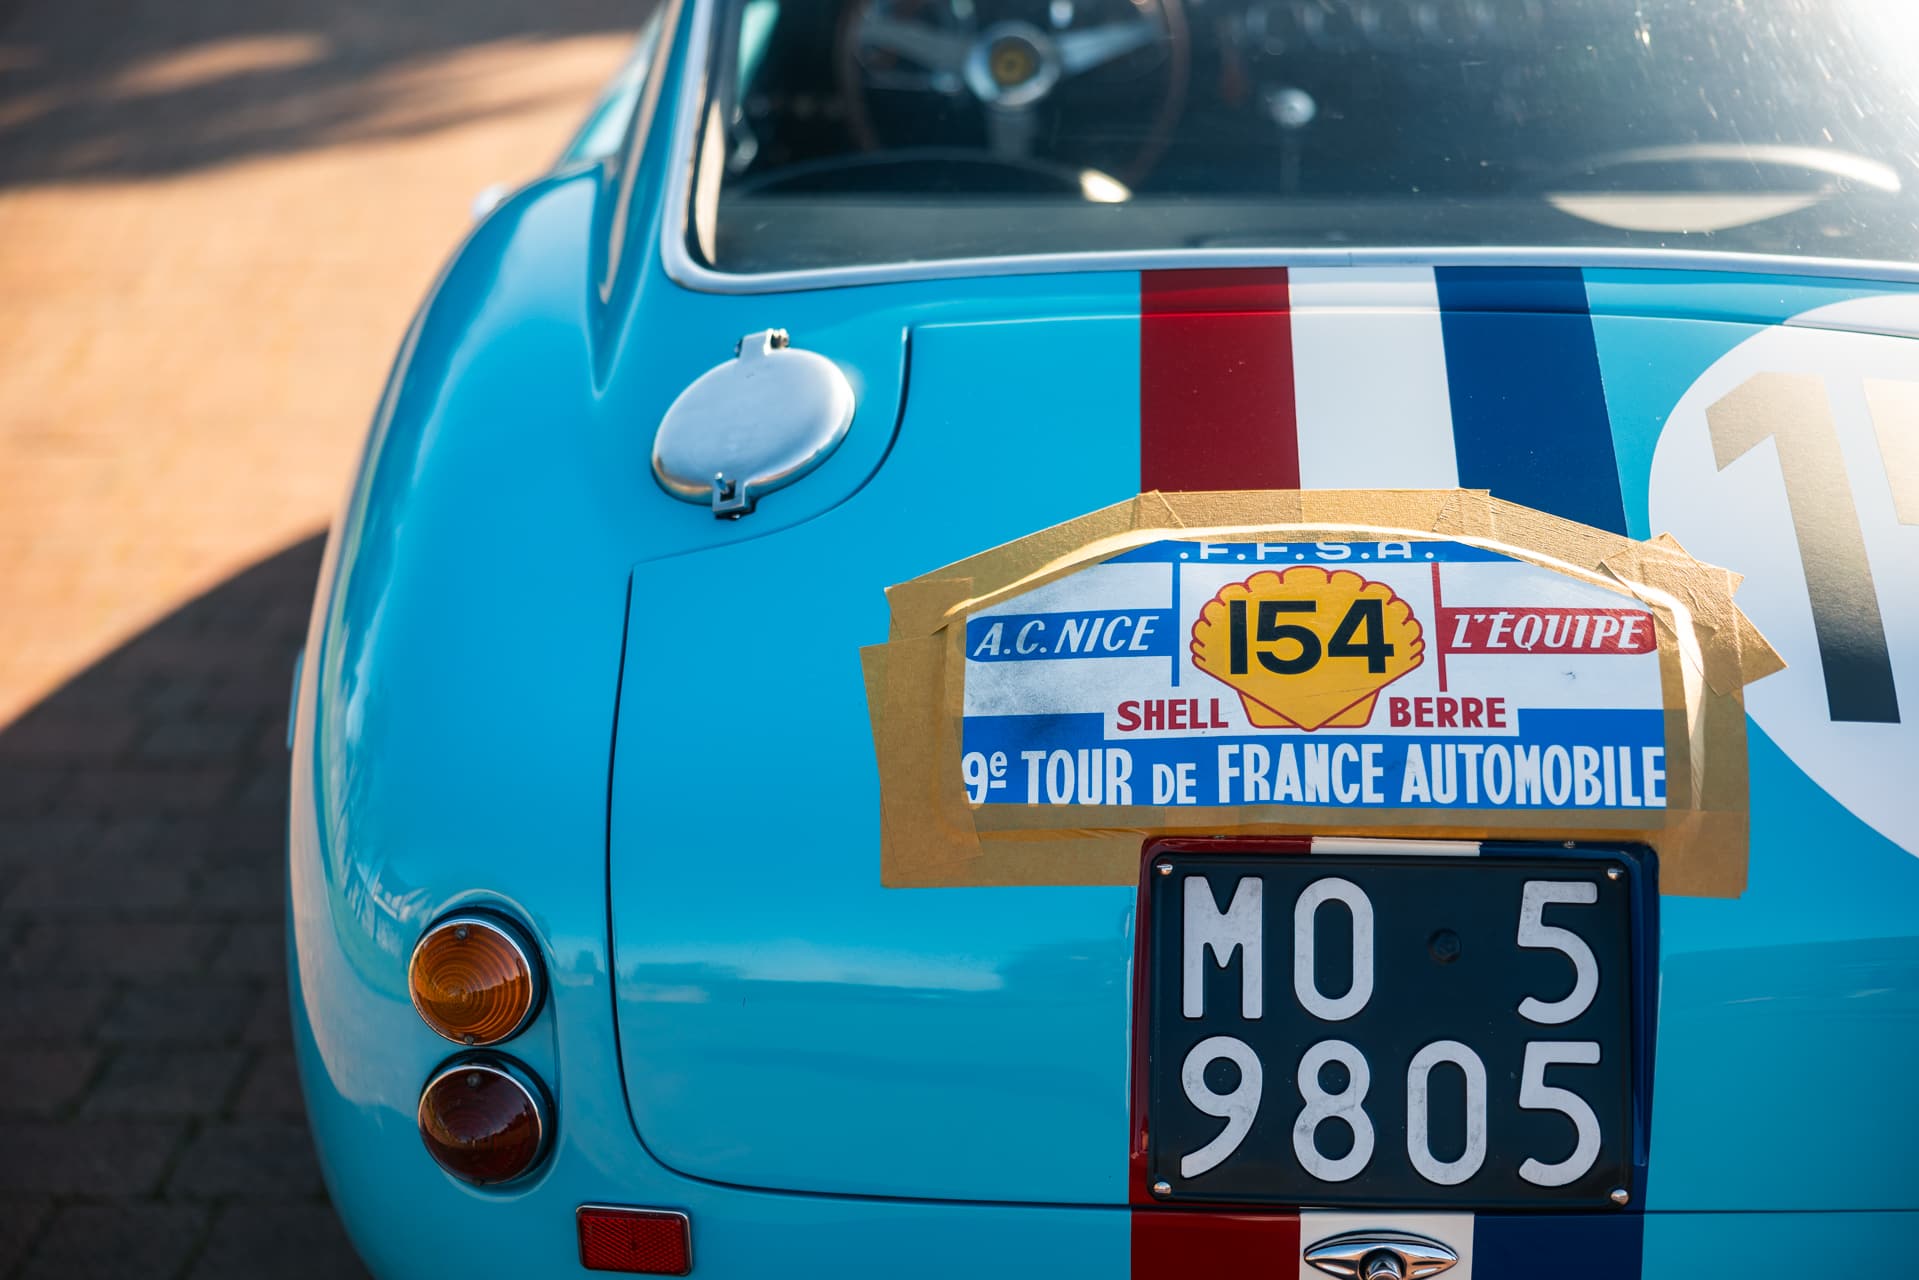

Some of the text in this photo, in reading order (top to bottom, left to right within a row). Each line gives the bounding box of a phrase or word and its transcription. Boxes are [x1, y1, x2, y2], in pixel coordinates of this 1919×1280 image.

[1706, 371, 1919, 723] 1
[1230, 599, 1394, 675] 154
[1451, 611, 1645, 651] L'ÉQUIPE
[1116, 697, 1507, 732] SHELL BERRE
[1021, 748, 1133, 806] TOUR
[1153, 763, 1197, 804] DE
[1218, 743, 1384, 803] FRANCE
[1401, 743, 1666, 807] AUTOMOBILE
[1183, 876, 1599, 1024] MO 5
[1180, 1035, 1601, 1187] 9805
